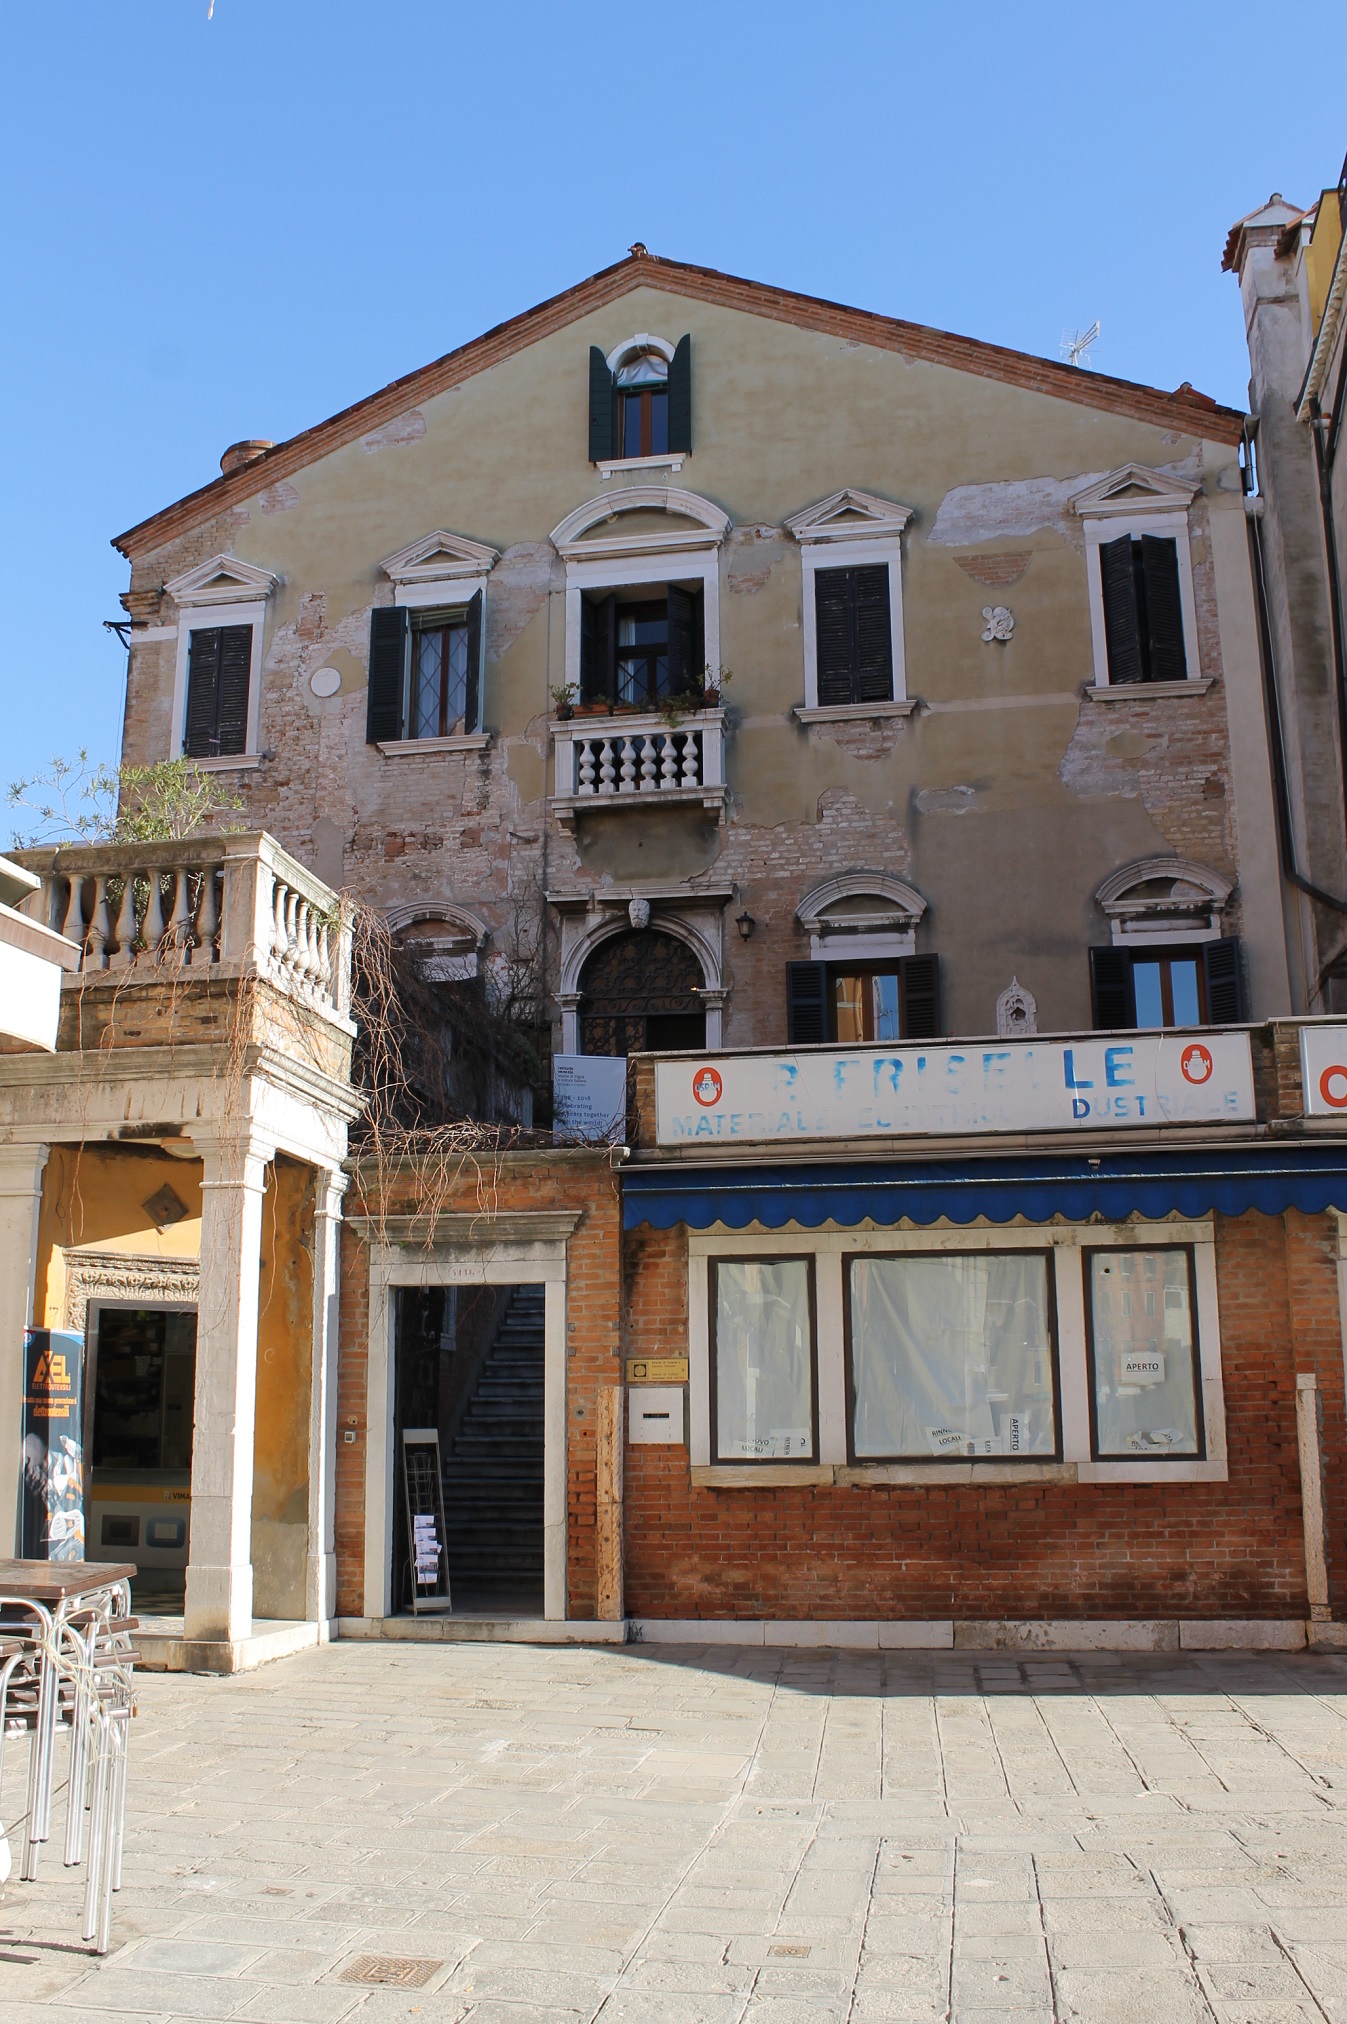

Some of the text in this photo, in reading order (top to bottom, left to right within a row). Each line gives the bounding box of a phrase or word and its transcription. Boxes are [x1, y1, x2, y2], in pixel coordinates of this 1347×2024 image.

[672, 1108, 831, 1137] MATERIALE
[1055, 1090, 1238, 1120] DUSTRIALE
[33, 1350, 71, 1383] AXEL
[1126, 1362, 1159, 1371] APERTO
[931, 1428, 953, 1437] RINN
[1011, 1418, 1020, 1451] APERTO
[938, 1435, 962, 1445] LOCALI
[172, 1492, 191, 1500] VIMA
